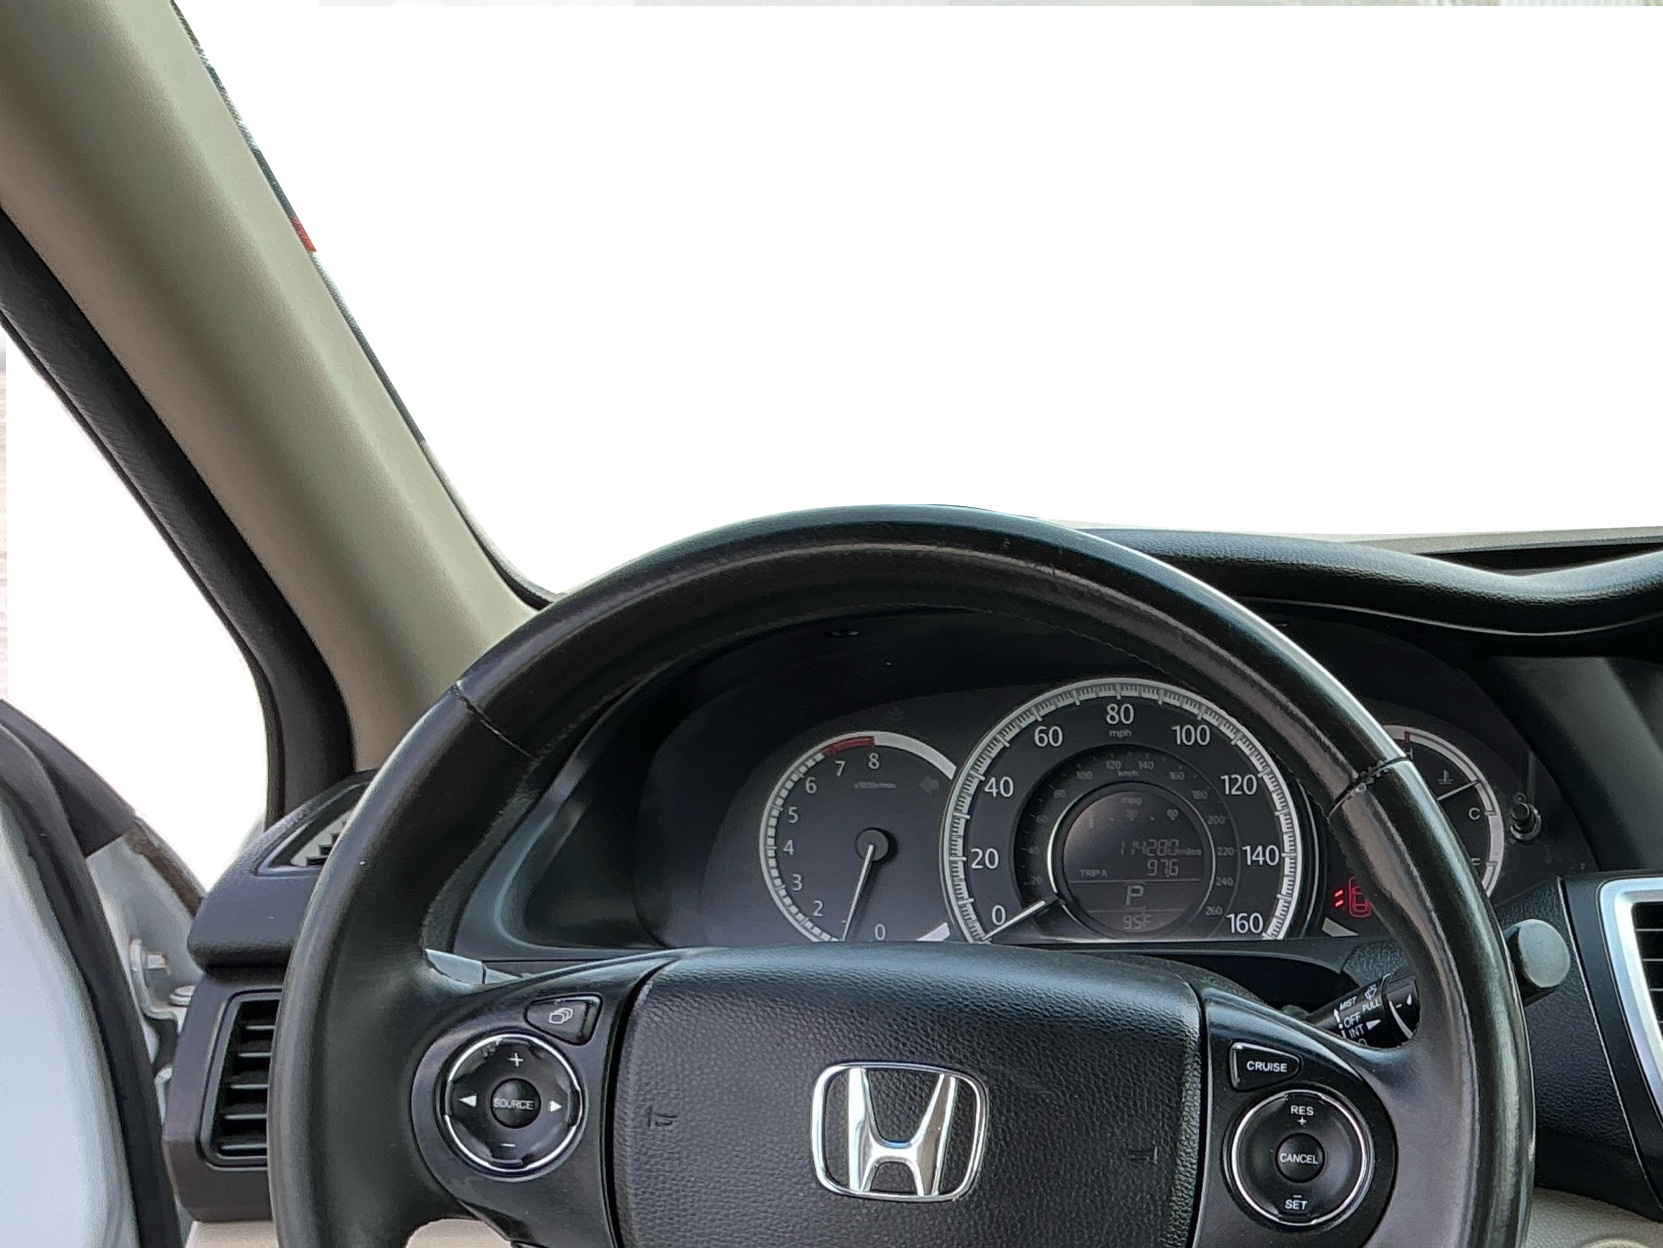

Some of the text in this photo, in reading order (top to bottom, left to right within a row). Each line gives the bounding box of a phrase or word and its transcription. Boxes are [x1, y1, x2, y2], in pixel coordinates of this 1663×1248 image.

[1106, 703, 1135, 725] 80
[1034, 726, 1063, 748] 60
[1109, 729, 1132, 738] mph
[1172, 724, 1211, 746] 100
[835, 760, 846, 777] 7
[868, 753, 880, 770] 8
[1105, 760, 1122, 770] 120
[1138, 760, 1155, 771] 140
[805, 777, 817, 794] 6
[984, 776, 1015, 798] 40
[1220, 774, 1258, 796] 120
[788, 806, 799, 824] 5
[1468, 807, 1481, 820] C
[783, 839, 795, 856] 4
[1241, 844, 1280, 867] 140
[970, 848, 999, 869] 20
[792, 874, 803, 891] 3
[1125, 885, 1144, 906] P
[813, 900, 824, 917] 2
[991, 904, 1006, 926] 0
[1226, 912, 1264, 934] 160
[874, 924, 886, 941] 0
[1339, 996, 1358, 1011] MIST
[1362, 998, 1381, 1013] PULL
[1343, 1011, 1361, 1028] OFF
[1348, 1023, 1365, 1039] INT
[1246, 1060, 1288, 1073] CRUISE
[493, 1098, 535, 1111] SOURCE
[1290, 1105, 1315, 1117] RES
[1279, 1152, 1319, 1165] CANCEL
[1284, 1199, 1309, 1211] SET
